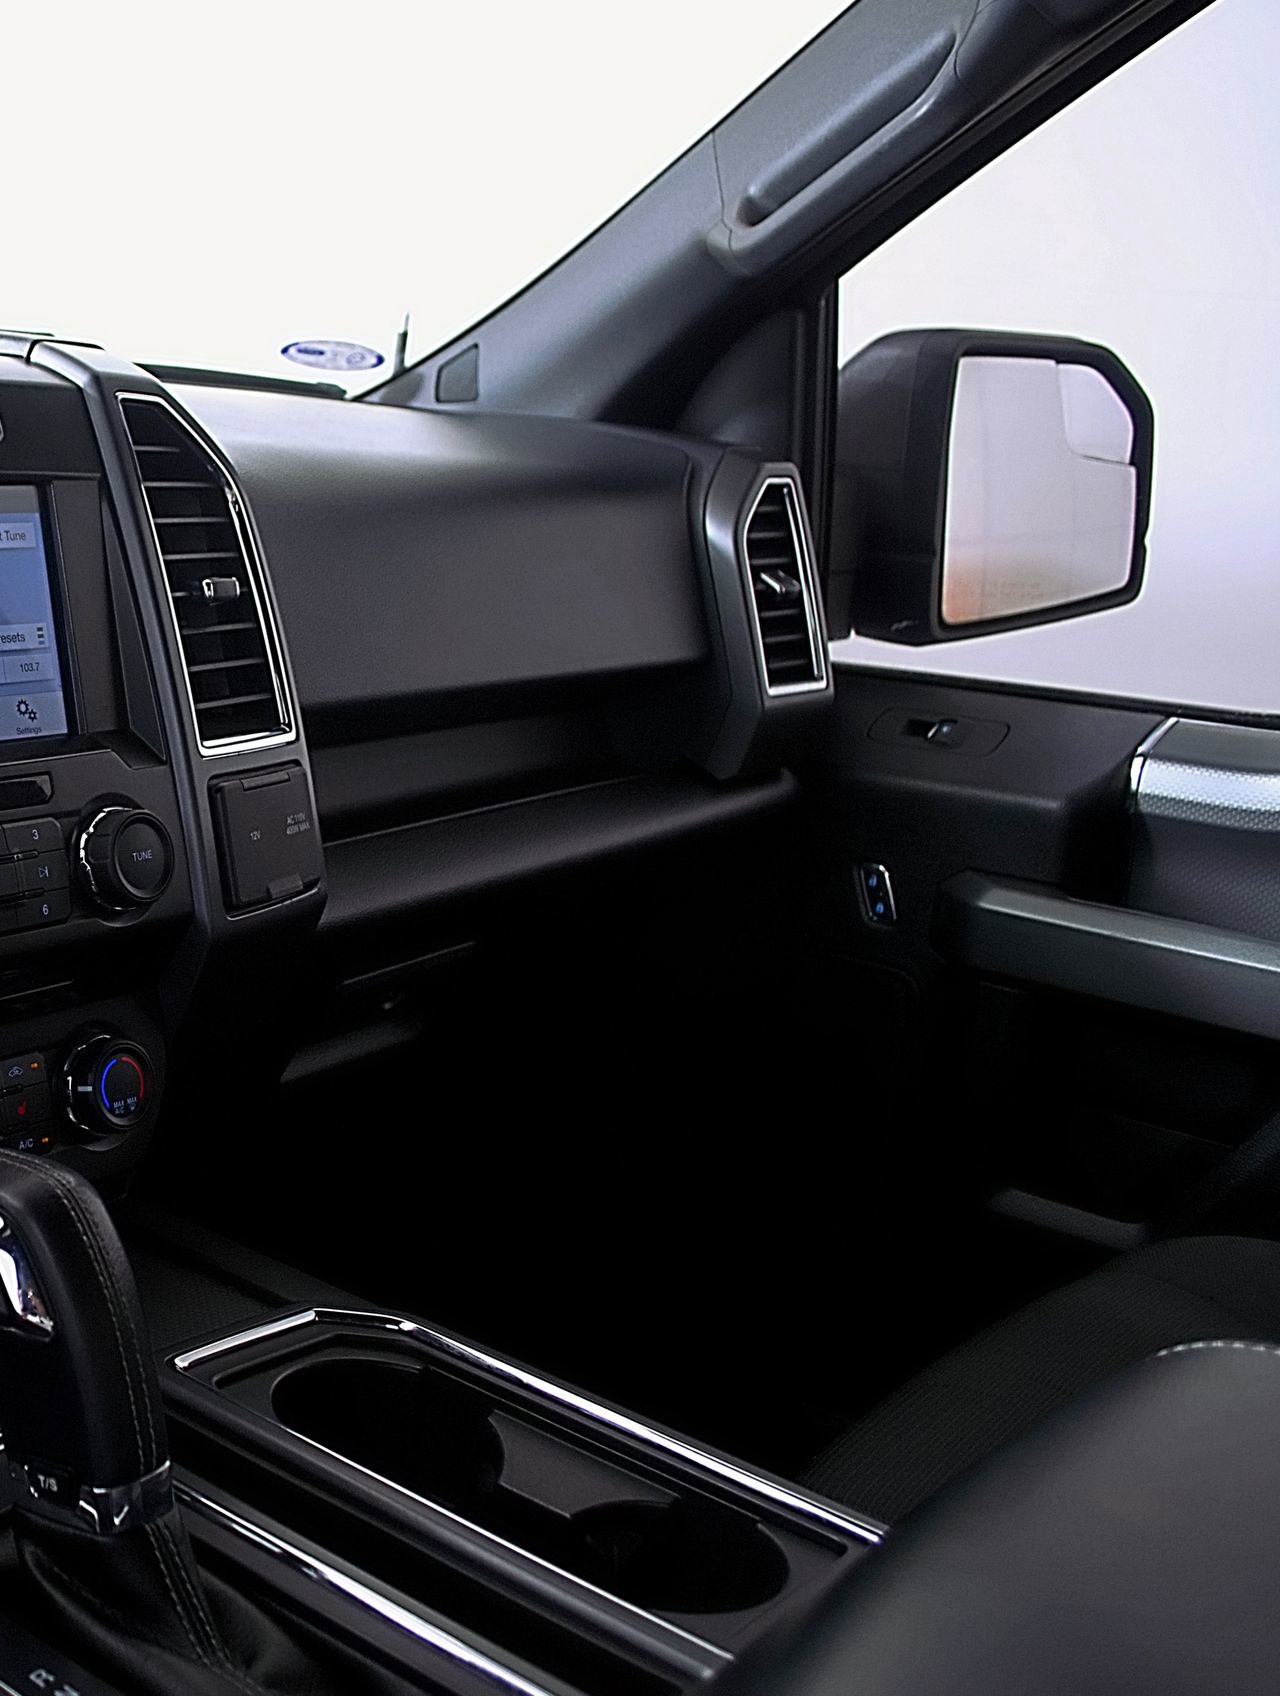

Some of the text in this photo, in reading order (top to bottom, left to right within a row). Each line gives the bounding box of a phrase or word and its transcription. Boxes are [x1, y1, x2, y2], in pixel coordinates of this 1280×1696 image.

[3, 529, 26, 542] Tune
[19, 661, 40, 673] 103.7
[16, 724, 42, 736] Settings
[31, 828, 40, 841] 3
[249, 830, 261, 841] 12V
[131, 848, 154, 862] TUNE
[42, 903, 50, 916] 6
[18, 1137, 34, 1151] A/C
[28, 1667, 56, 1689] R
